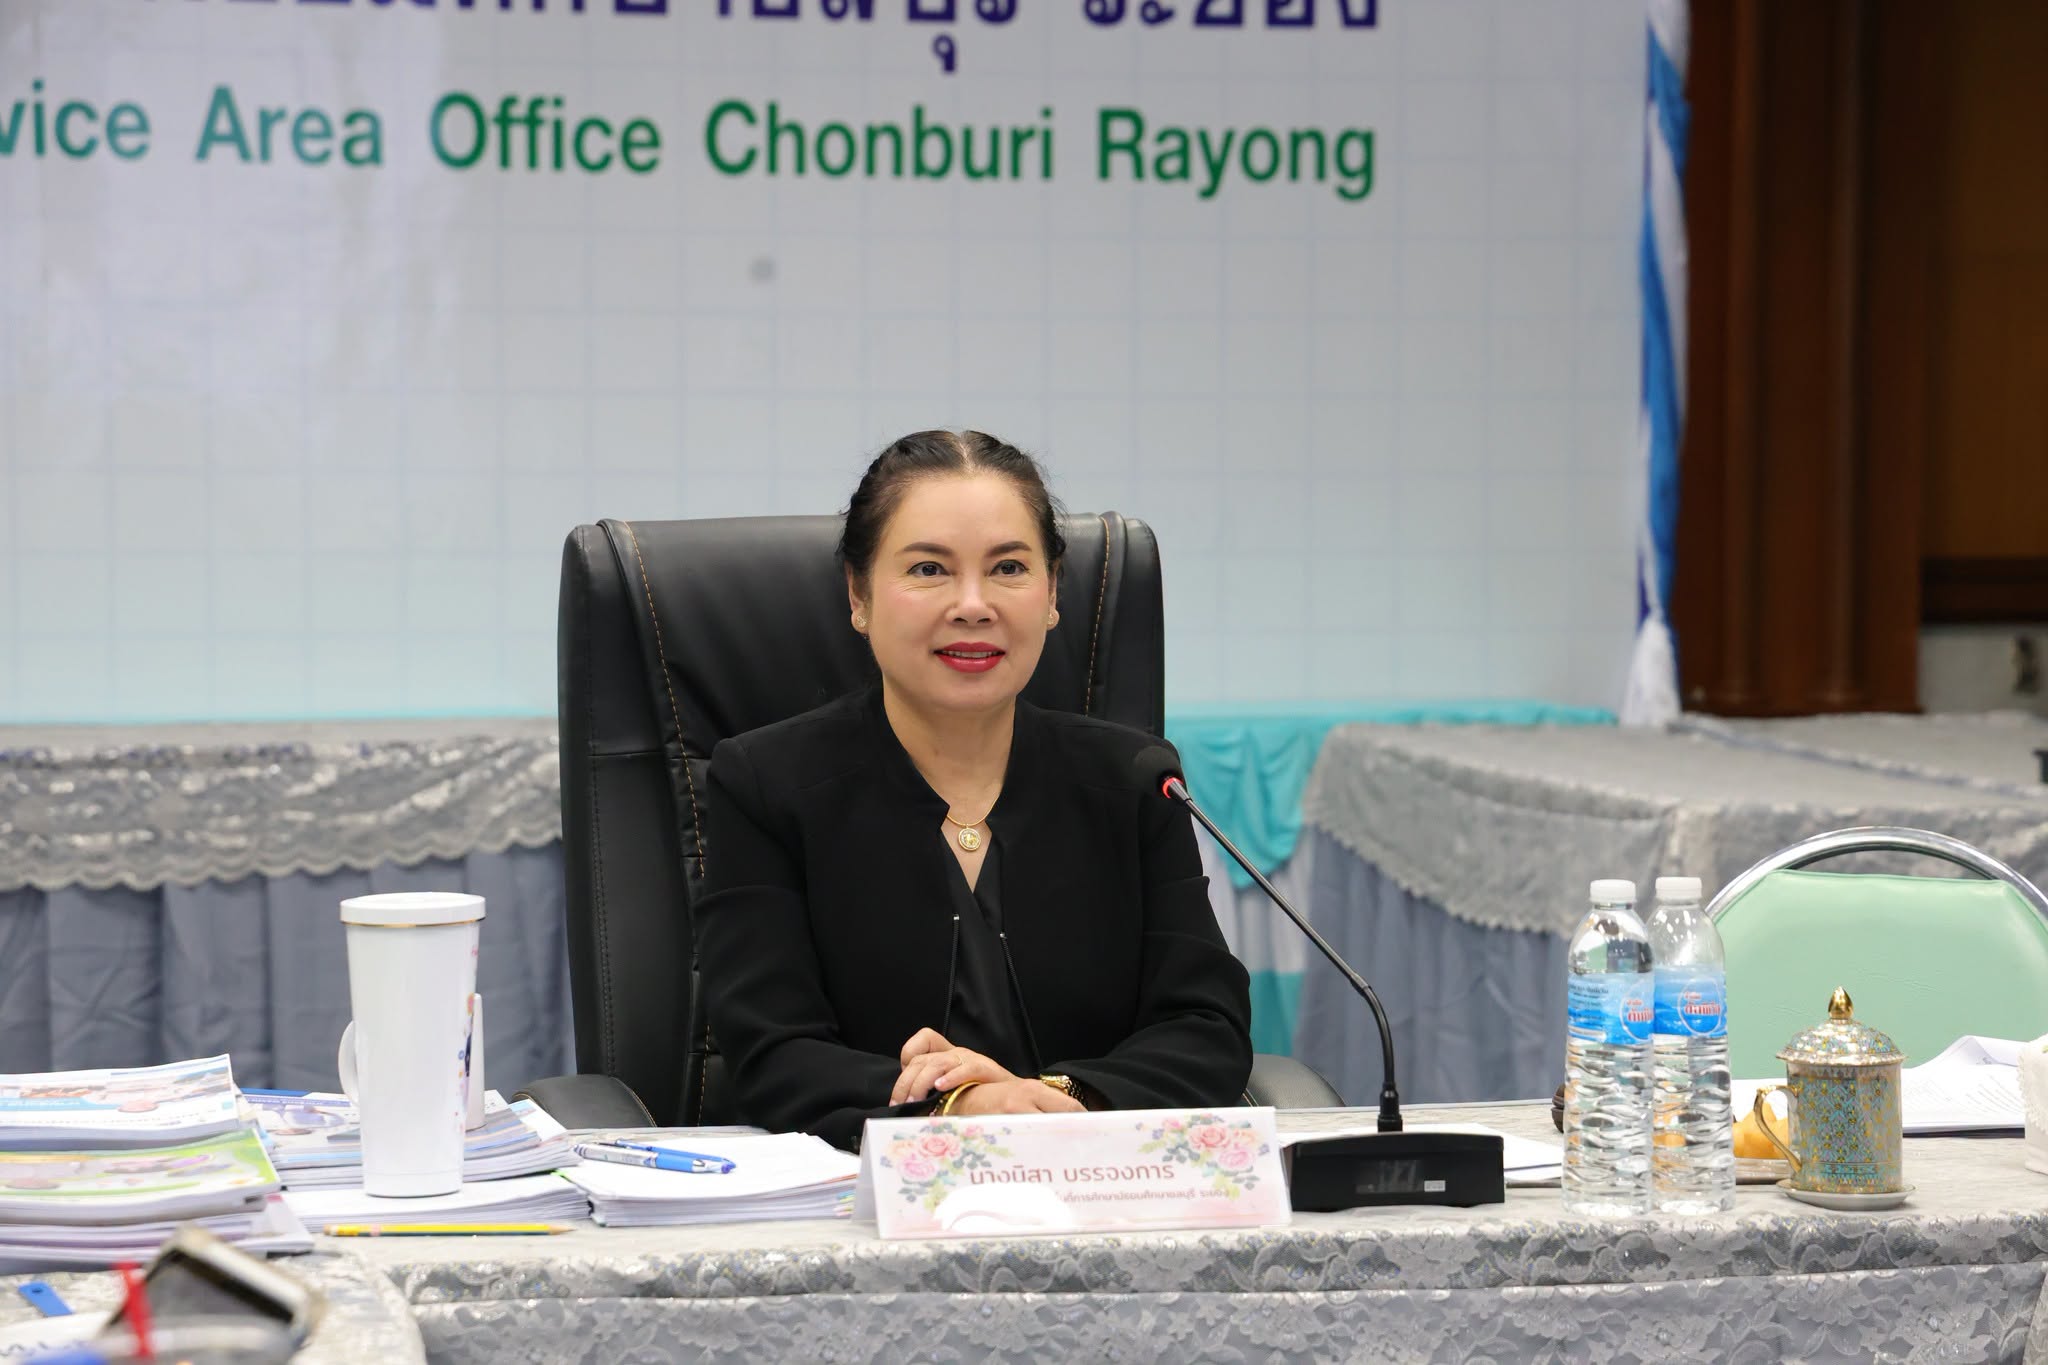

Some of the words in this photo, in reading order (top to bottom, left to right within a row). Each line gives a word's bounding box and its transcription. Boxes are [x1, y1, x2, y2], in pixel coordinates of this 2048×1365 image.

[0, 79, 149, 158] vice
[196, 86, 383, 165] Area
[430, 91, 661, 173] Office
[705, 100, 1052, 179] Chonburi
[1098, 108, 1374, 200] Rayong
